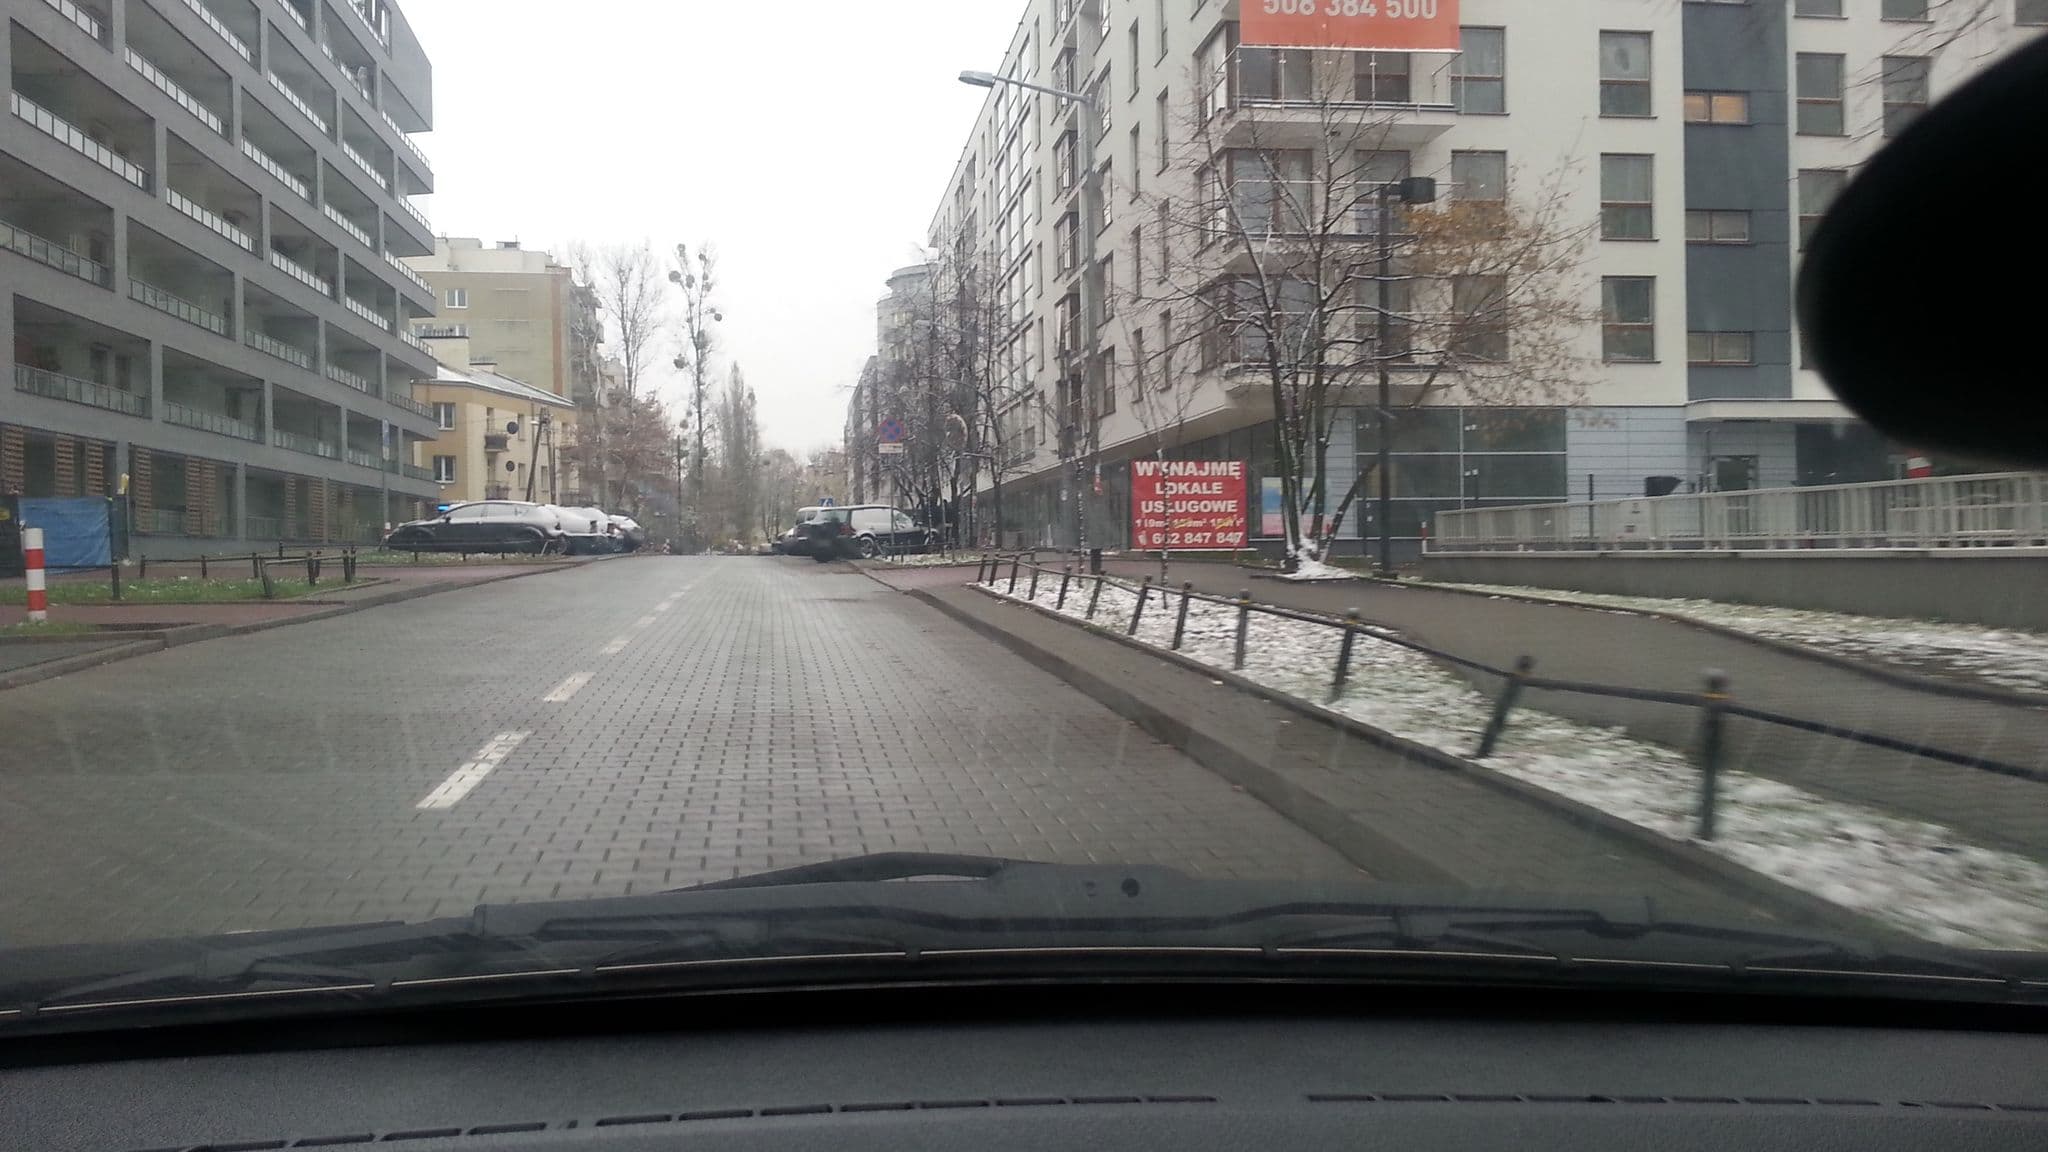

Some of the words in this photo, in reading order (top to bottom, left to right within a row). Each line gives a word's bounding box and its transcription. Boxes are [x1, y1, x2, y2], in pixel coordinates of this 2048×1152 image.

[1264, 0, 1316, 15] 508
[1324, 0, 1377, 17] 384
[1385, 0, 1437, 19] 500
[1135, 461, 1241, 480] WYNAJMĘ
[1155, 482, 1223, 495] LOKALE
[1141, 500, 1238, 513] USŁUGOWE
[1184, 532, 1212, 544] 847
